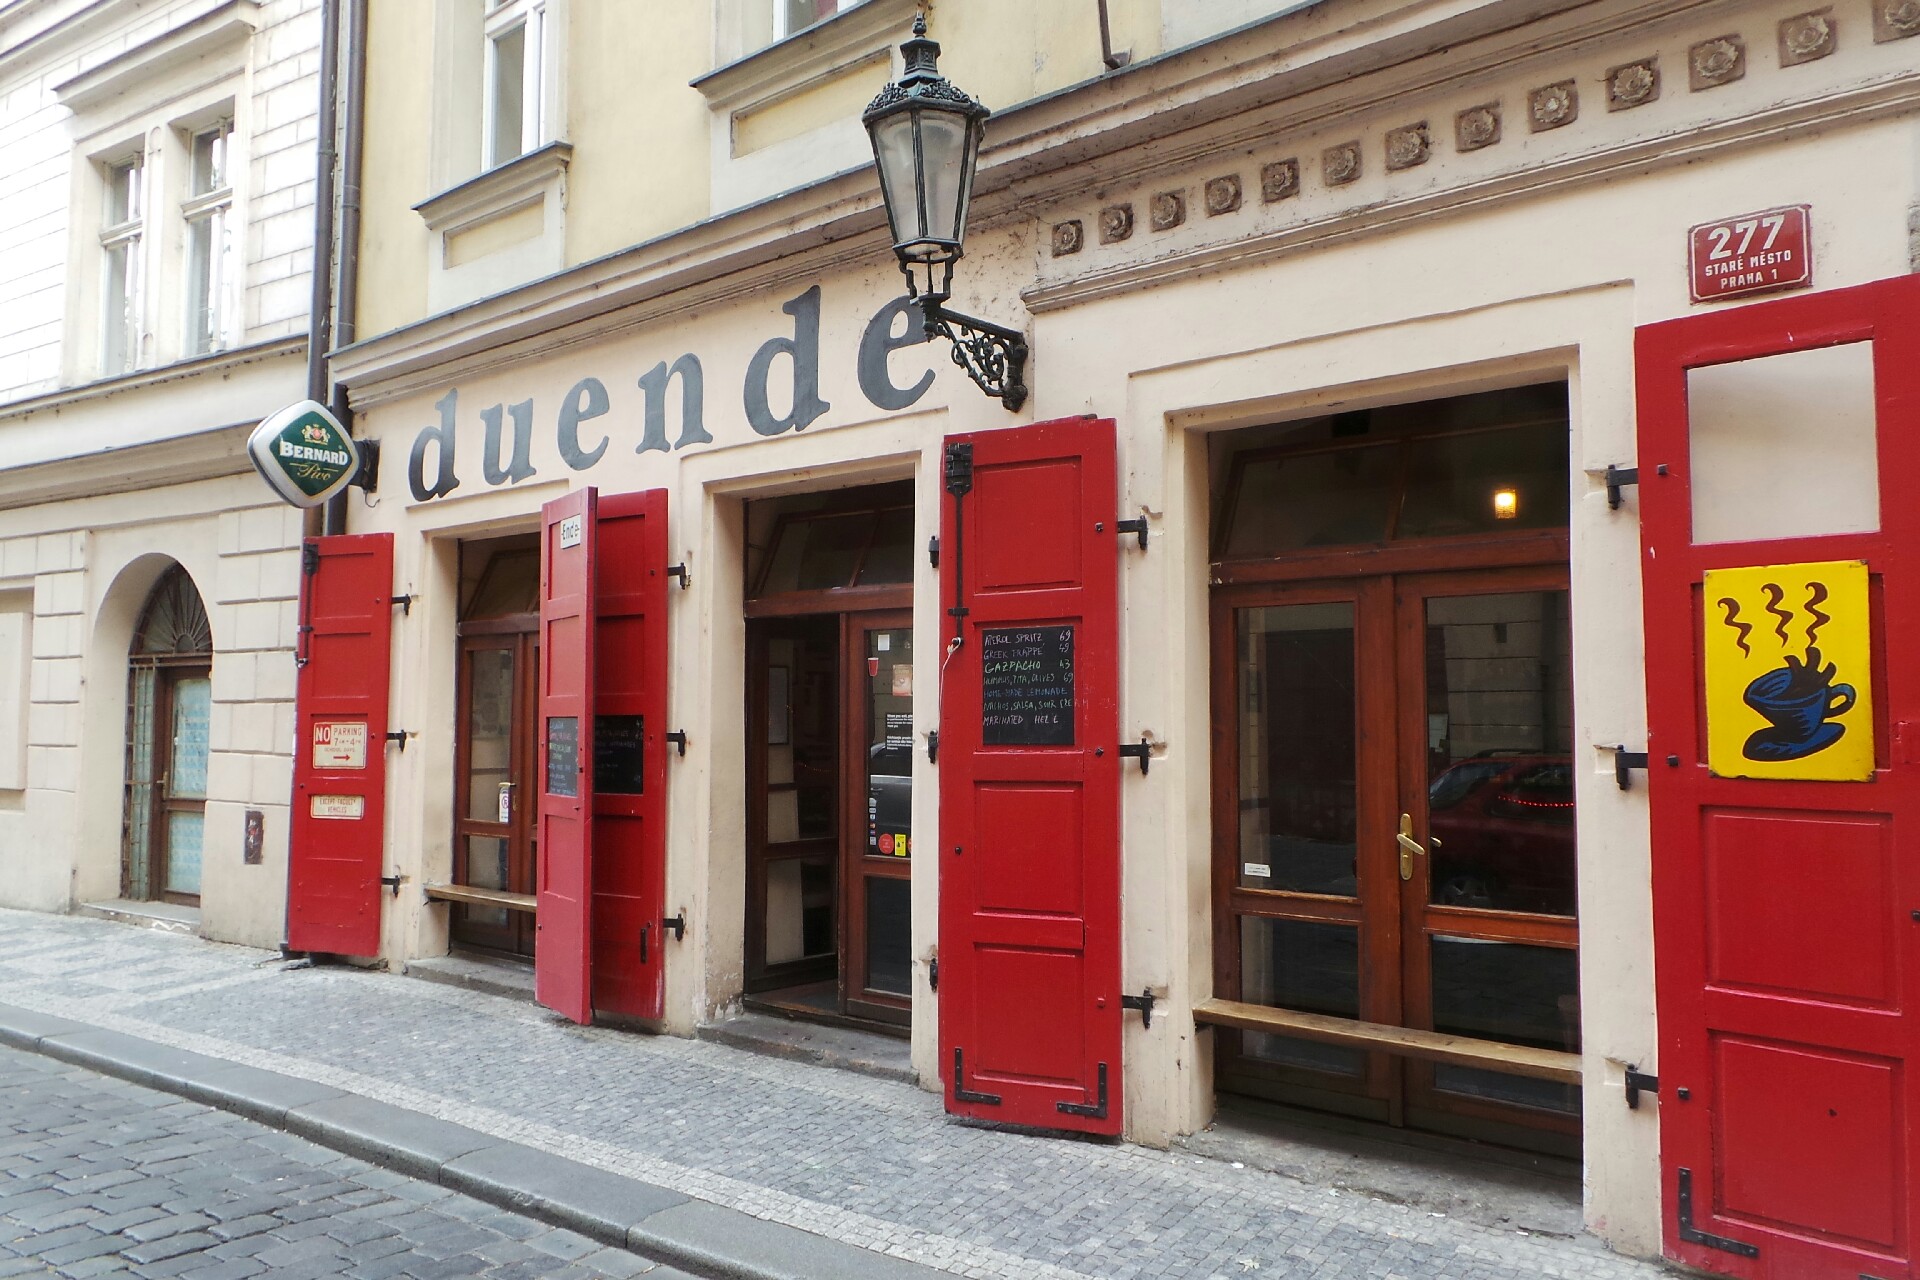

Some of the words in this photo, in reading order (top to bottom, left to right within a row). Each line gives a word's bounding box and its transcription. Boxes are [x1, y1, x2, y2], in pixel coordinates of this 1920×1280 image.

[1708, 214, 1785, 260] 277
[1705, 256, 1744, 276] STARÉ
[1750, 250, 1792, 268] MĚSTO
[1720, 271, 1763, 289] PRAHA
[1771, 268, 1778, 280] 1
[408, 284, 936, 501] duende
[279, 438, 349, 466] BERNARD
[297, 462, 331, 480] Pivo
[1016, 633, 1043, 643] SPRITZ
[984, 649, 1009, 660] GREEK
[984, 660, 1041, 674] GAZPACHO
[983, 714, 1024, 726] MARINATED
[315, 726, 331, 742] NO
[333, 728, 362, 737] PARKING
